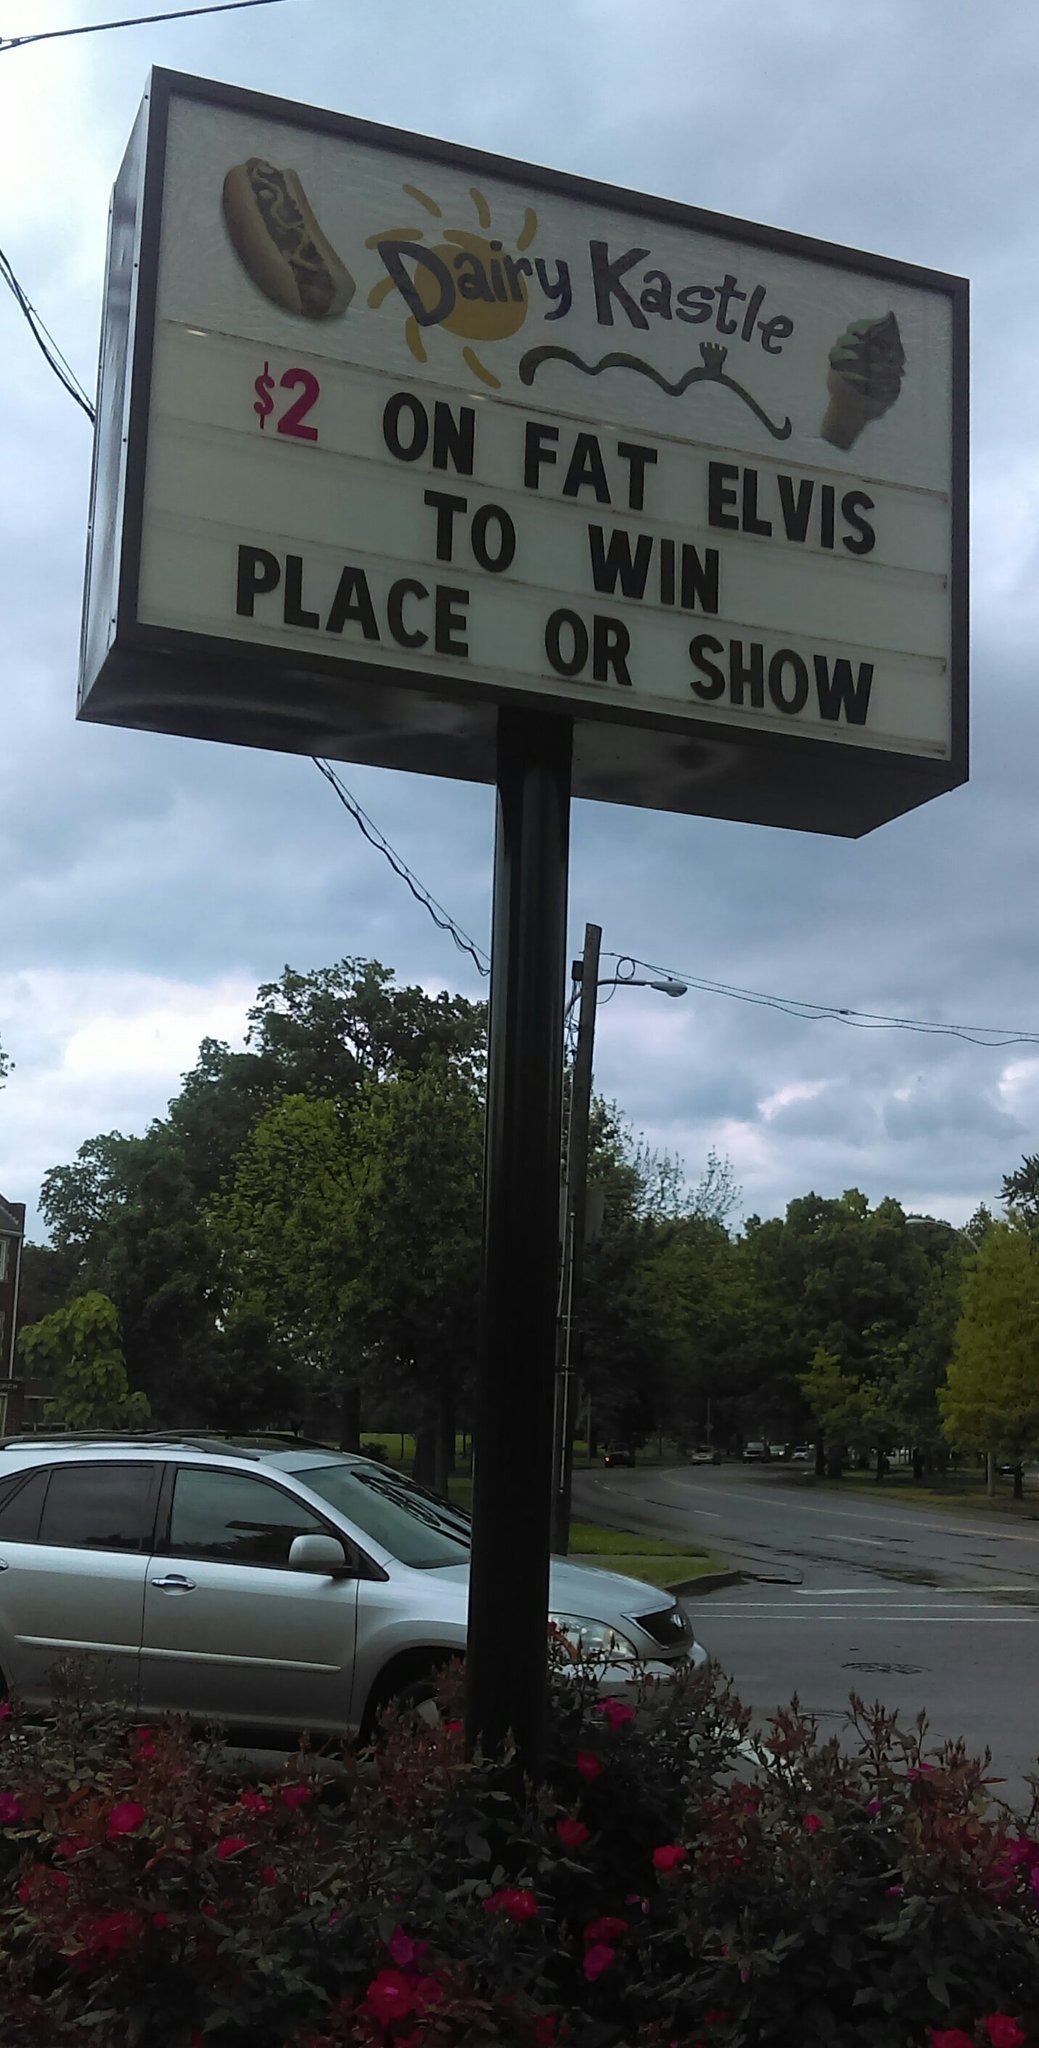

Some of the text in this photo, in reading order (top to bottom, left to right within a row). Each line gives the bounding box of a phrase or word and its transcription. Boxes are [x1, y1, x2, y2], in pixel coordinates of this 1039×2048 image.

[378, 240, 794, 354] Dairy Kastle
[254, 361, 876, 556] $2 ON FAT ELVIS
[424, 489, 720, 615] TO WIN
[236, 544, 874, 726] PLACE OR SHOW
